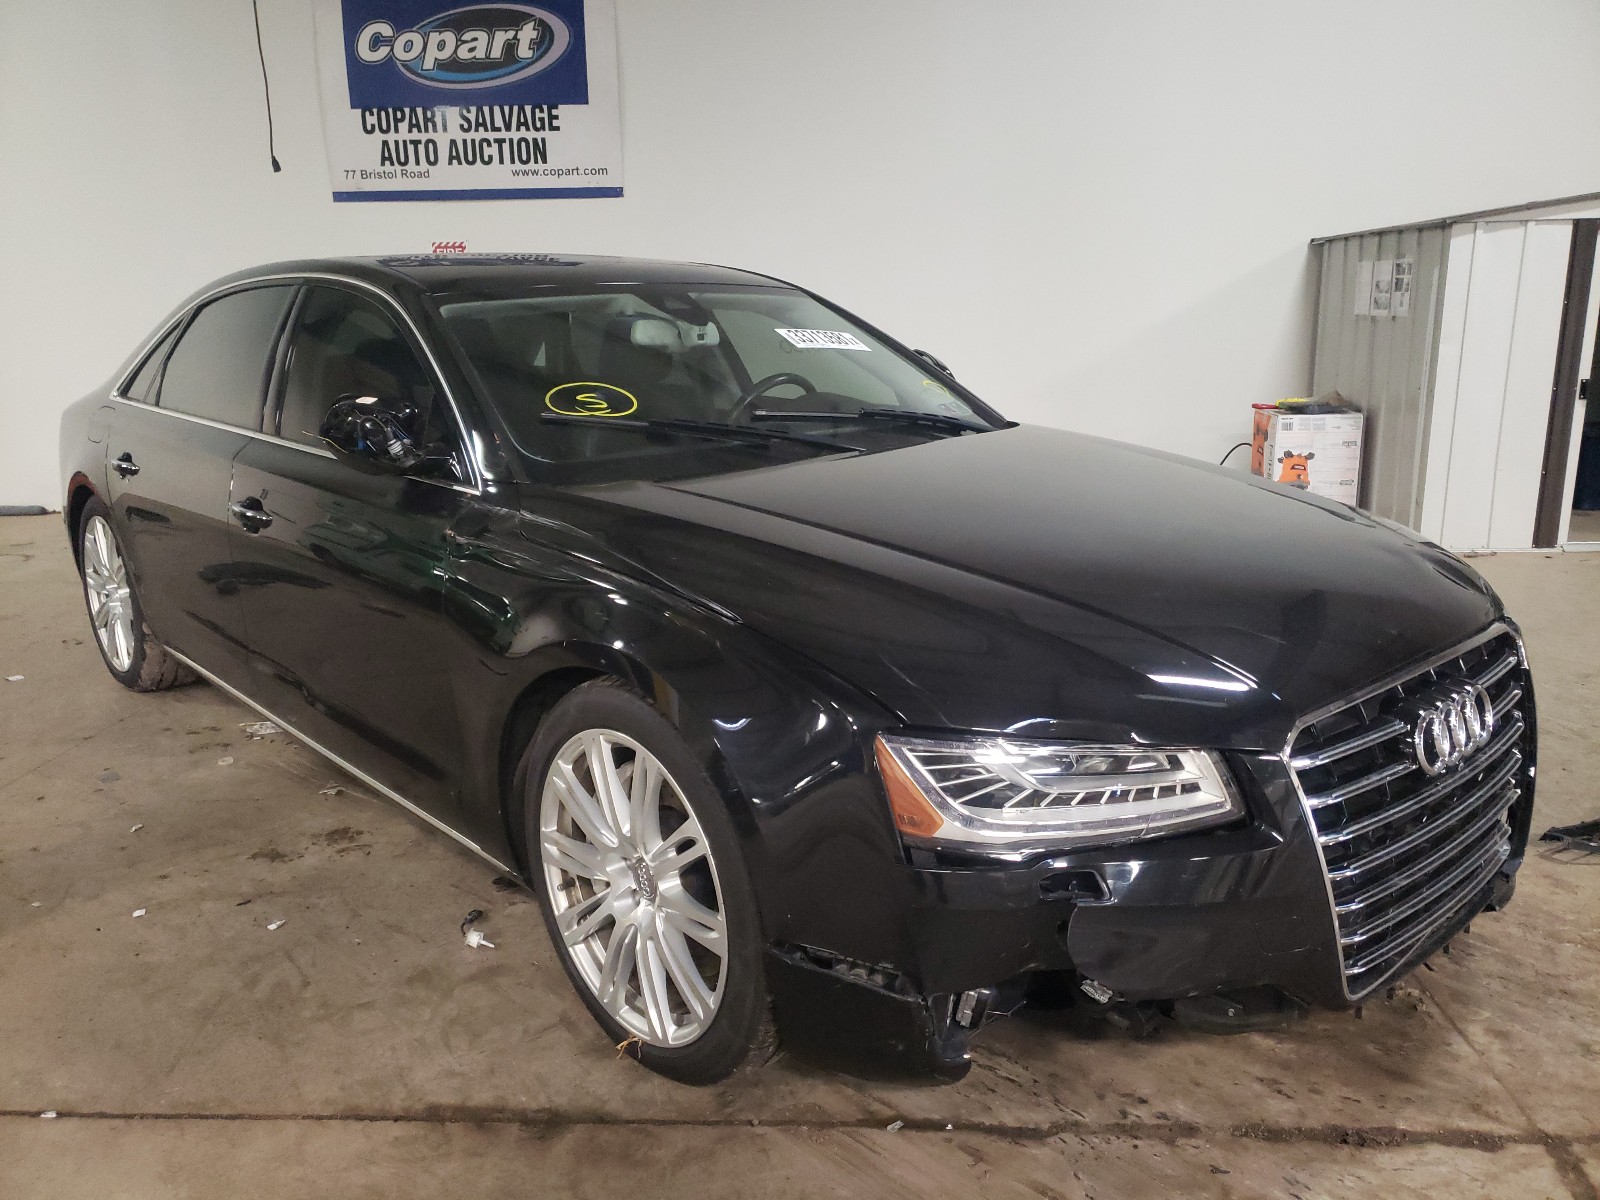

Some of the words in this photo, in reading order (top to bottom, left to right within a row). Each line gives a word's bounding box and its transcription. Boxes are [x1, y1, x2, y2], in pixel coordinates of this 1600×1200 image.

[356, 17, 541, 72] Copart
[361, 104, 449, 135] COPART
[459, 104, 561, 133] SALVAGE
[380, 139, 439, 167] AUTO
[448, 137, 548, 166] AUCTION
[344, 170, 356, 180] 77
[360, 169, 398, 180] Bristol
[401, 168, 430, 179] Road
[511, 165, 608, 178] www.copart.com
